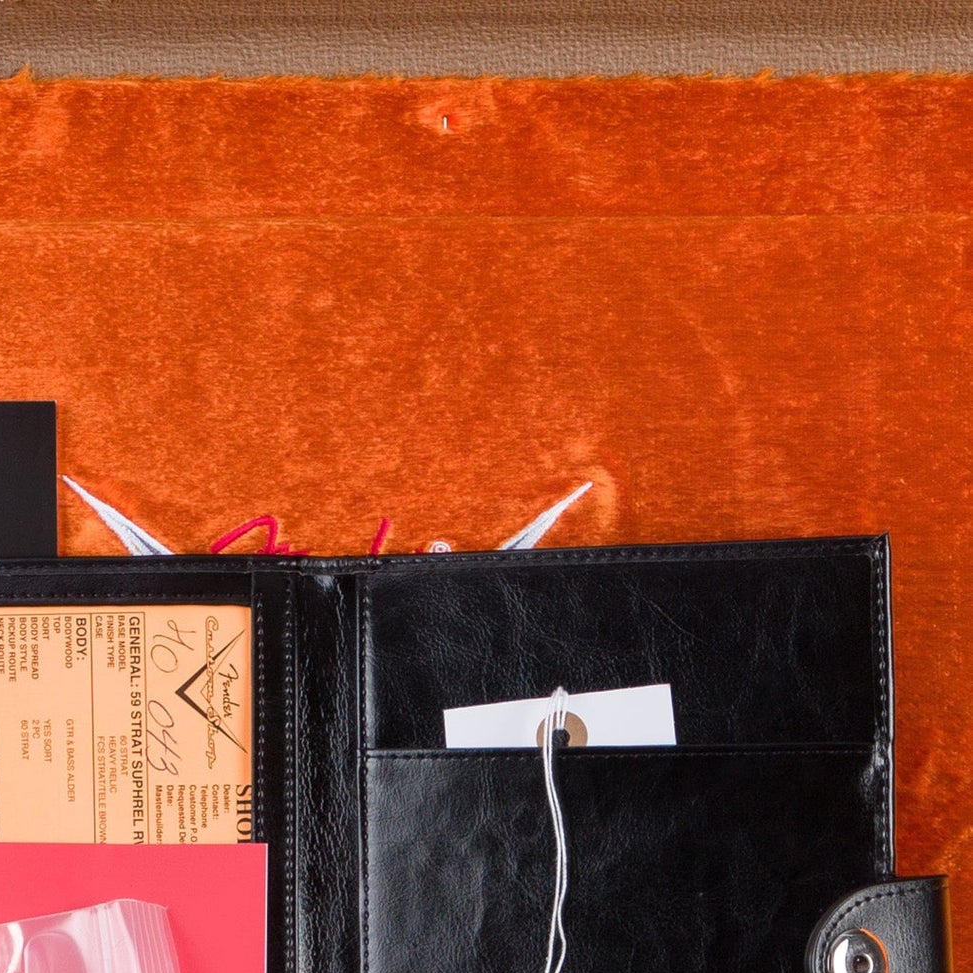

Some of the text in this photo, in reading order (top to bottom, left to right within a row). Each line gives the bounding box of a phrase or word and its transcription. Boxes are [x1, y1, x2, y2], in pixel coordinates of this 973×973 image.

[76, 618, 86, 661] BODY:
[95, 616, 103, 638] CASE
[31, 644, 39, 679] SPREAD
[107, 646, 115, 668] TYPE
[118, 641, 126, 672] MODEL
[219, 664, 240, 718] Fender
[33, 727, 40, 739] PC
[129, 616, 143, 826] GENERAL: 59 STRAT SUPHREL
[109, 736, 117, 764] HEAVY
[67, 773, 75, 802] ALDER
[98, 756, 106, 808] STRAT/TELE
[223, 784, 231, 813] Dealer:
[155, 785, 163, 844] Masterbuilder:
[177, 785, 186, 829] Requested
[189, 785, 197, 825] Customer
[200, 785, 208, 828] Telephone
